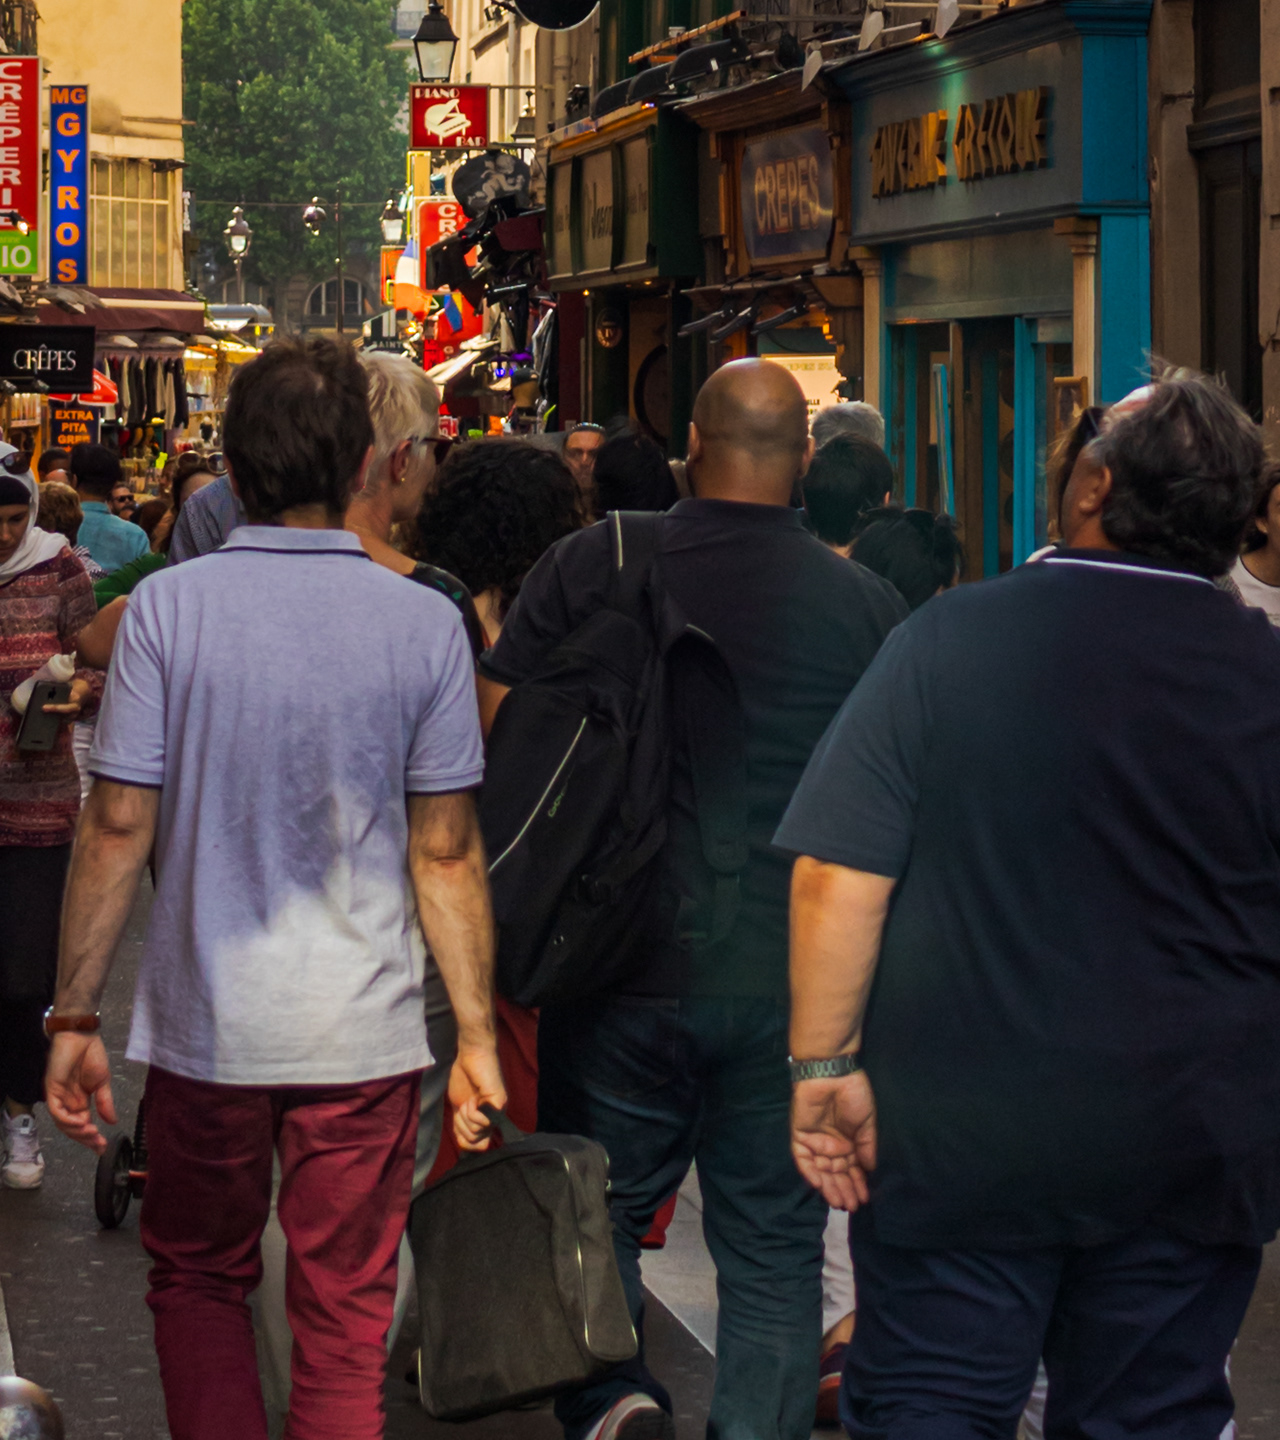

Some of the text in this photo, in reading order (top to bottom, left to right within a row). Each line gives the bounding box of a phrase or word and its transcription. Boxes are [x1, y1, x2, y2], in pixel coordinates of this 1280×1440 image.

[51, 87, 87, 104] MG
[414, 87, 461, 99] PIANO
[455, 136, 486, 148] BAR
[55, 112, 81, 282] GYROS
[13, 343, 76, 371] CRÊPES
[55, 410, 94, 421] EXTRA
[62, 423, 87, 433] PITA
